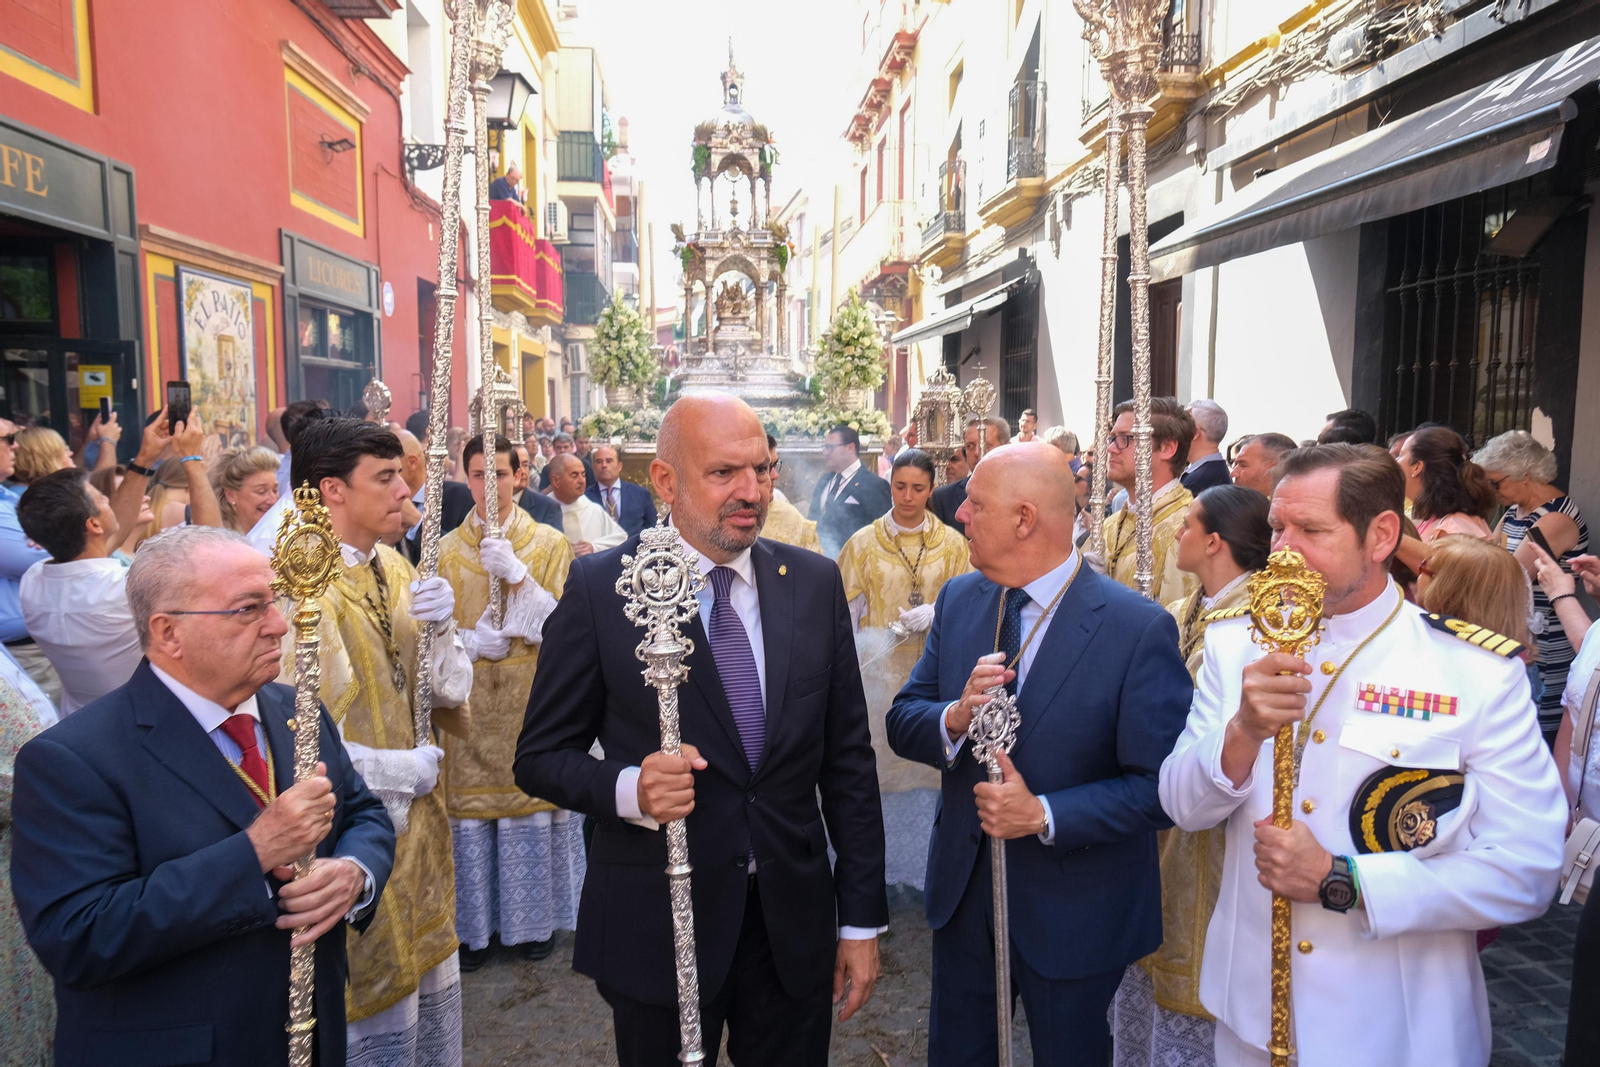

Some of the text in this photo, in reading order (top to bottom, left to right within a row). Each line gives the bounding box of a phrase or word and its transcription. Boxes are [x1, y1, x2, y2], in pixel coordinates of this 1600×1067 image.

[308, 256, 362, 295] LICORES
[194, 290, 246, 340] EL PATIO
